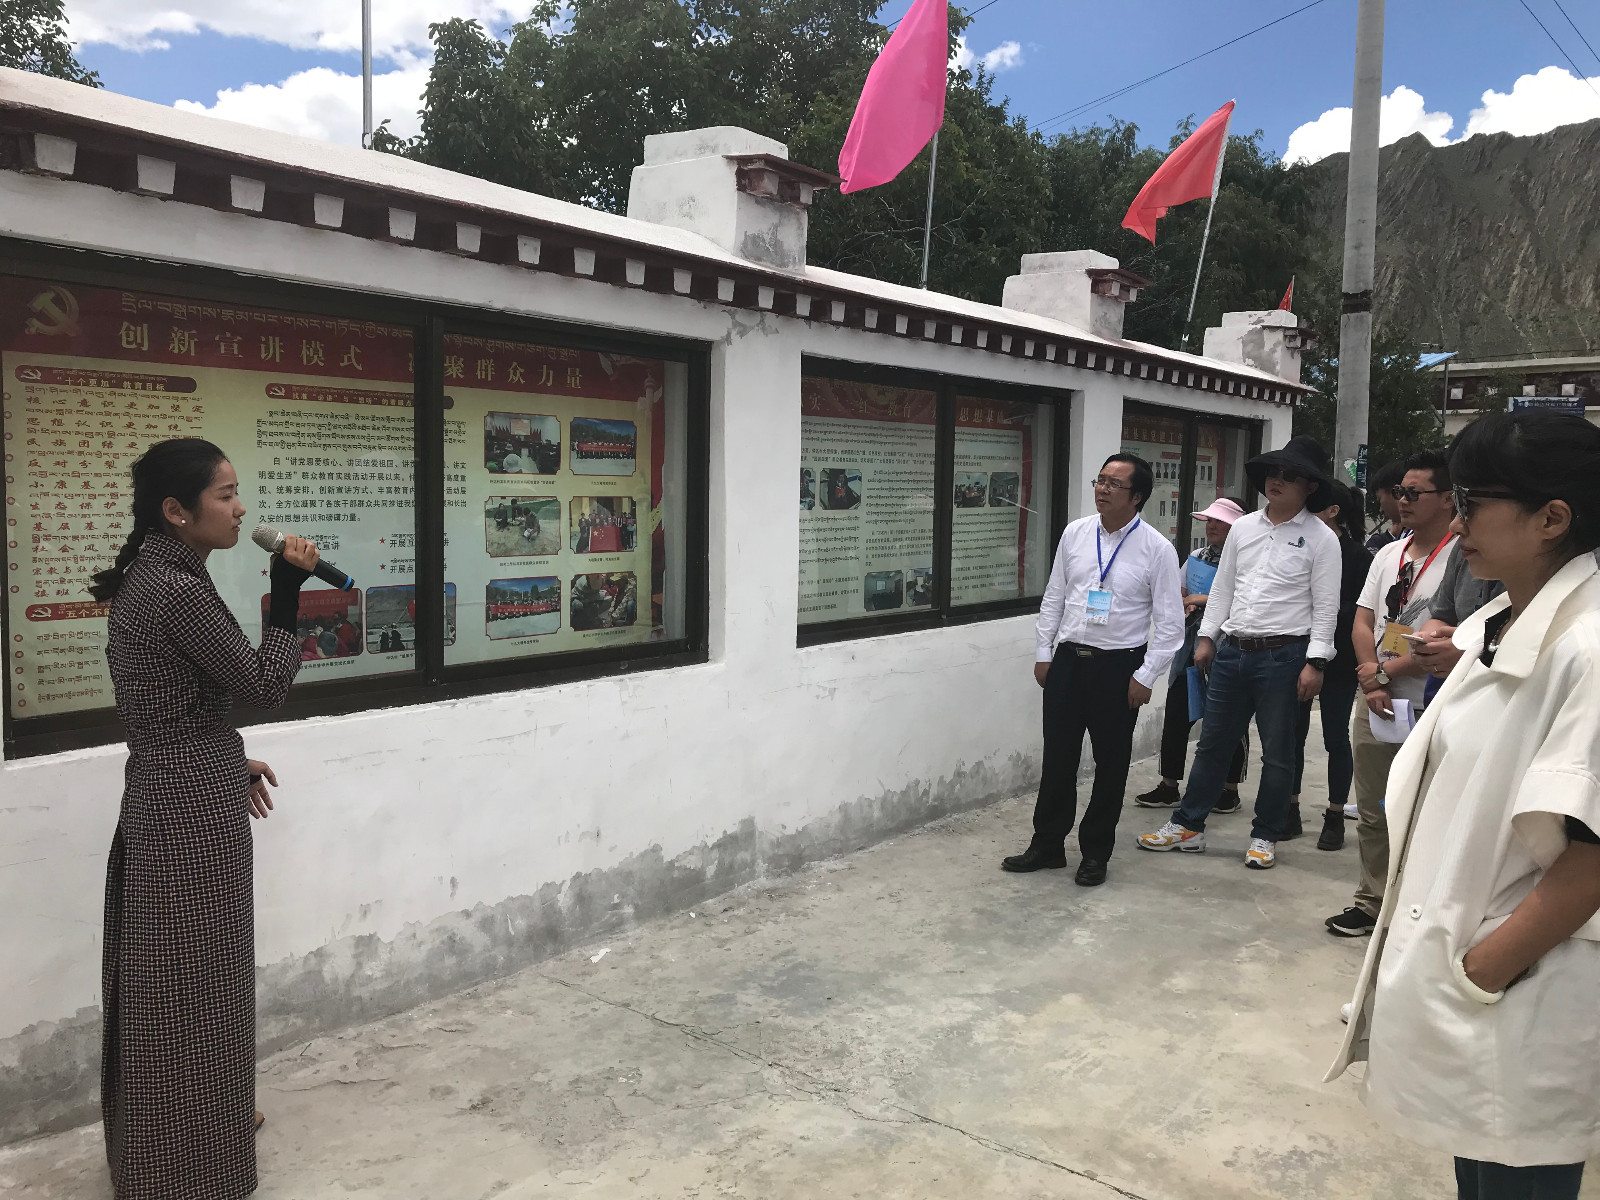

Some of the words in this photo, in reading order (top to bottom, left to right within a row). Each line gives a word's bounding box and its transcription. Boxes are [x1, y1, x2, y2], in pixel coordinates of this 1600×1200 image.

[119, 321, 363, 371] 创新宣讲模式
[409, 353, 583, 389] 聚群众力量
[26, 438, 154, 451] 民族团结更
[28, 459, 133, 470] 反对分裂
[29, 481, 133, 490] 小康基础
[29, 501, 134, 511] 生态保护
